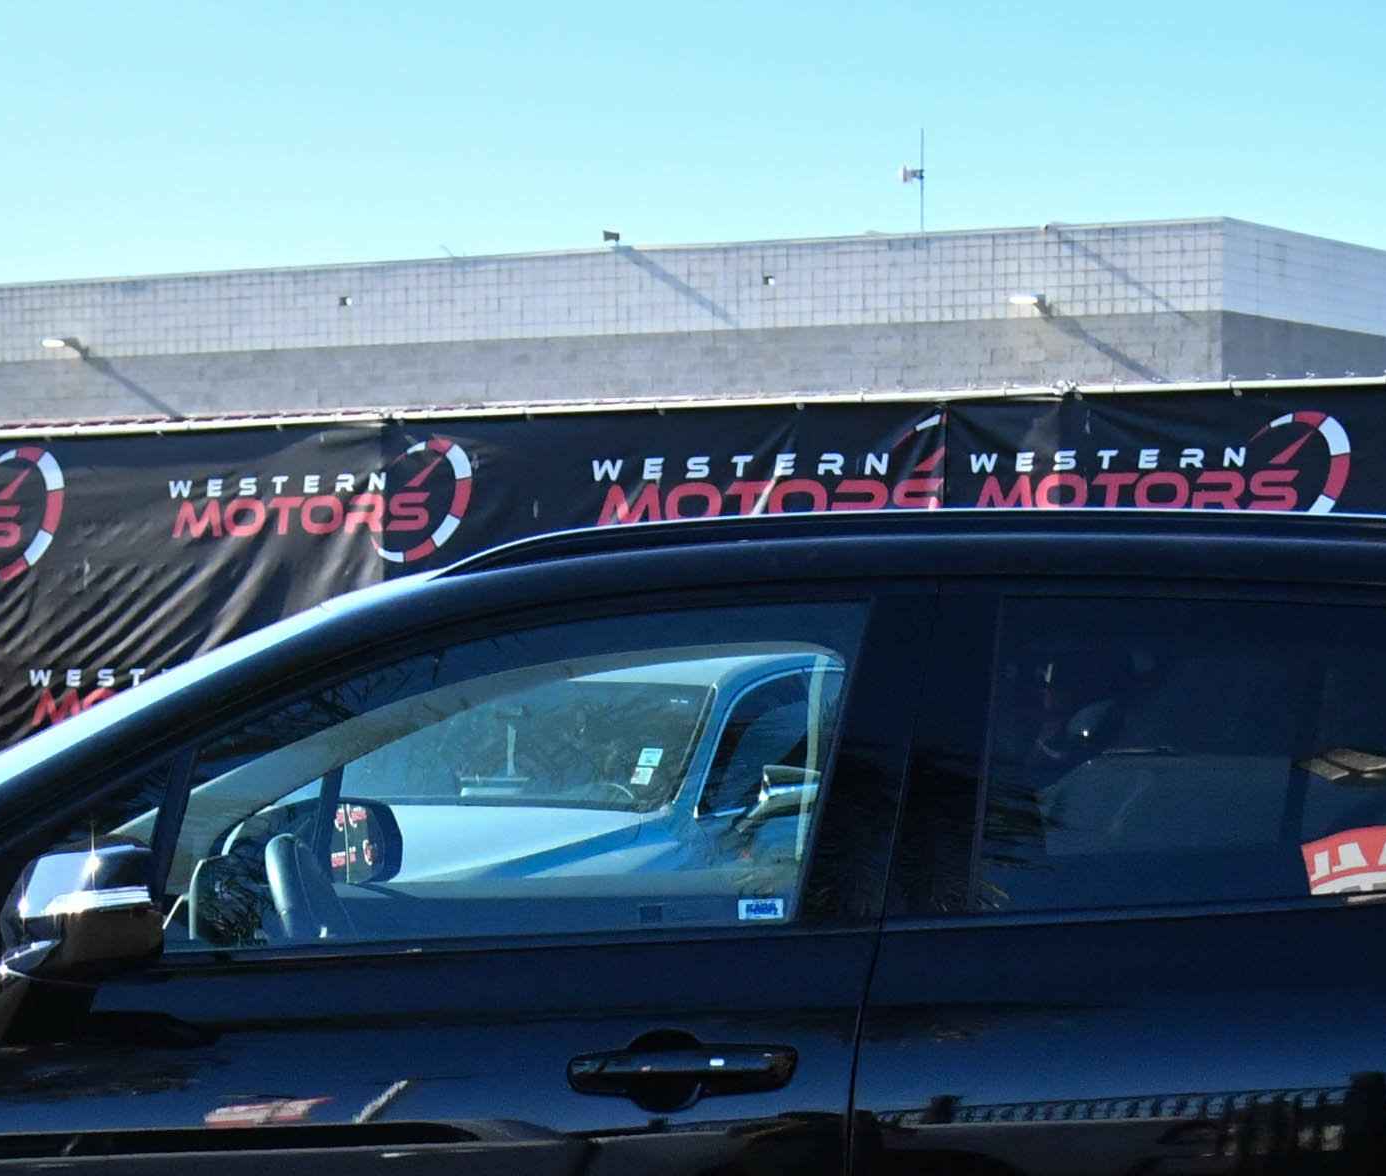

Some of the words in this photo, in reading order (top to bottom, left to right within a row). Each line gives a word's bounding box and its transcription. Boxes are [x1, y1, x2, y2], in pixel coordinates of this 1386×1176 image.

[592, 453, 889, 482] WESTERN
[970, 447, 1247, 474] WESTERN
[168, 472, 387, 499] WESTERN
[977, 469, 1300, 511] MOTORS
[172, 492, 431, 539] MOTORS
[29, 668, 171, 688] WEST
